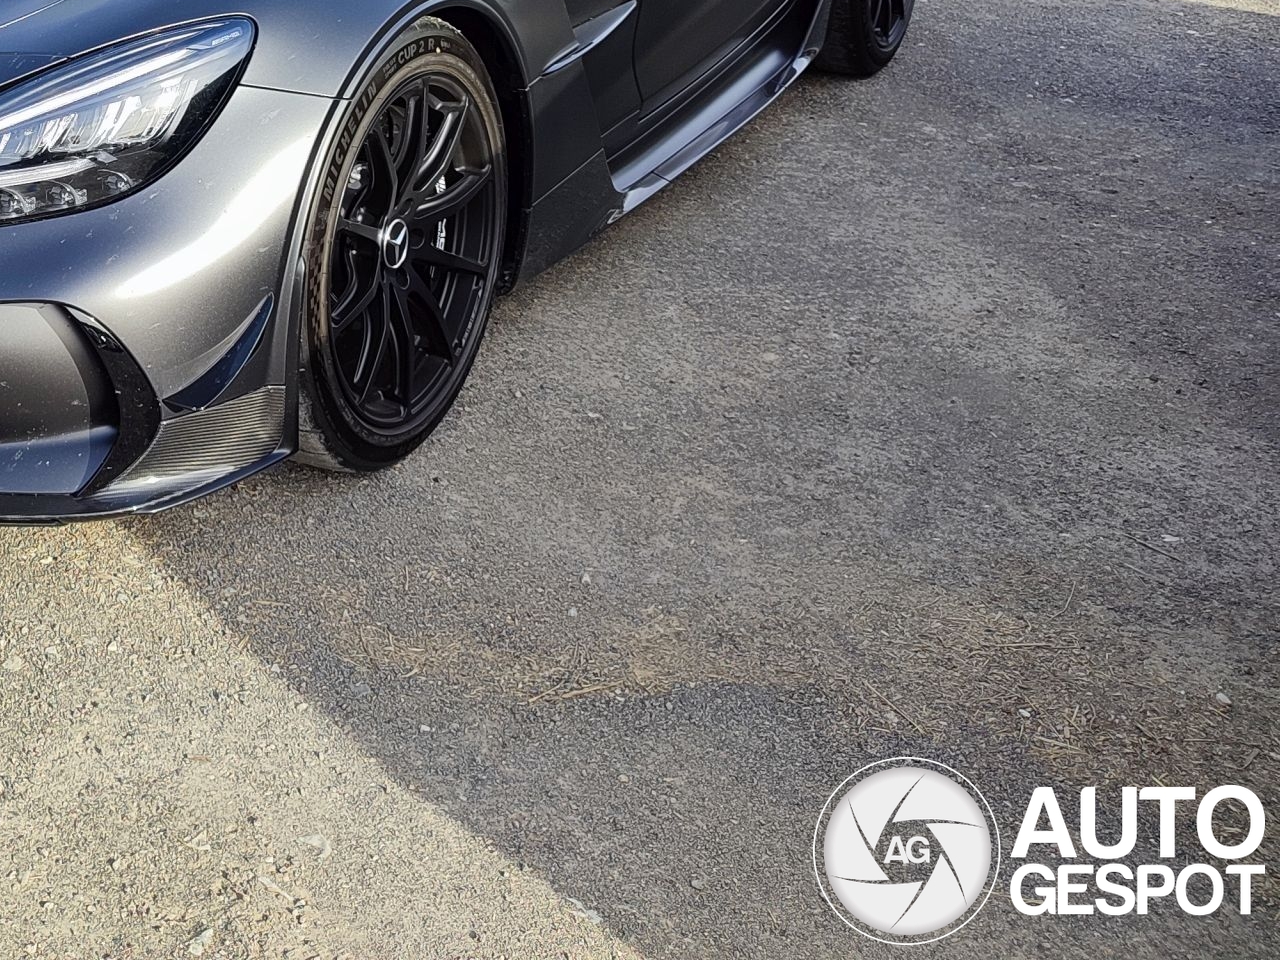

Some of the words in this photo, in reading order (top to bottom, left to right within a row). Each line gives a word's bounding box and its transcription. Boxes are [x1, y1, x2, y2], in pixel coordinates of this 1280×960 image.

[398, 44, 417, 65] CUP
[419, 41, 425, 52] 2
[428, 40, 435, 51] R
[323, 81, 378, 202] MICHELIN
